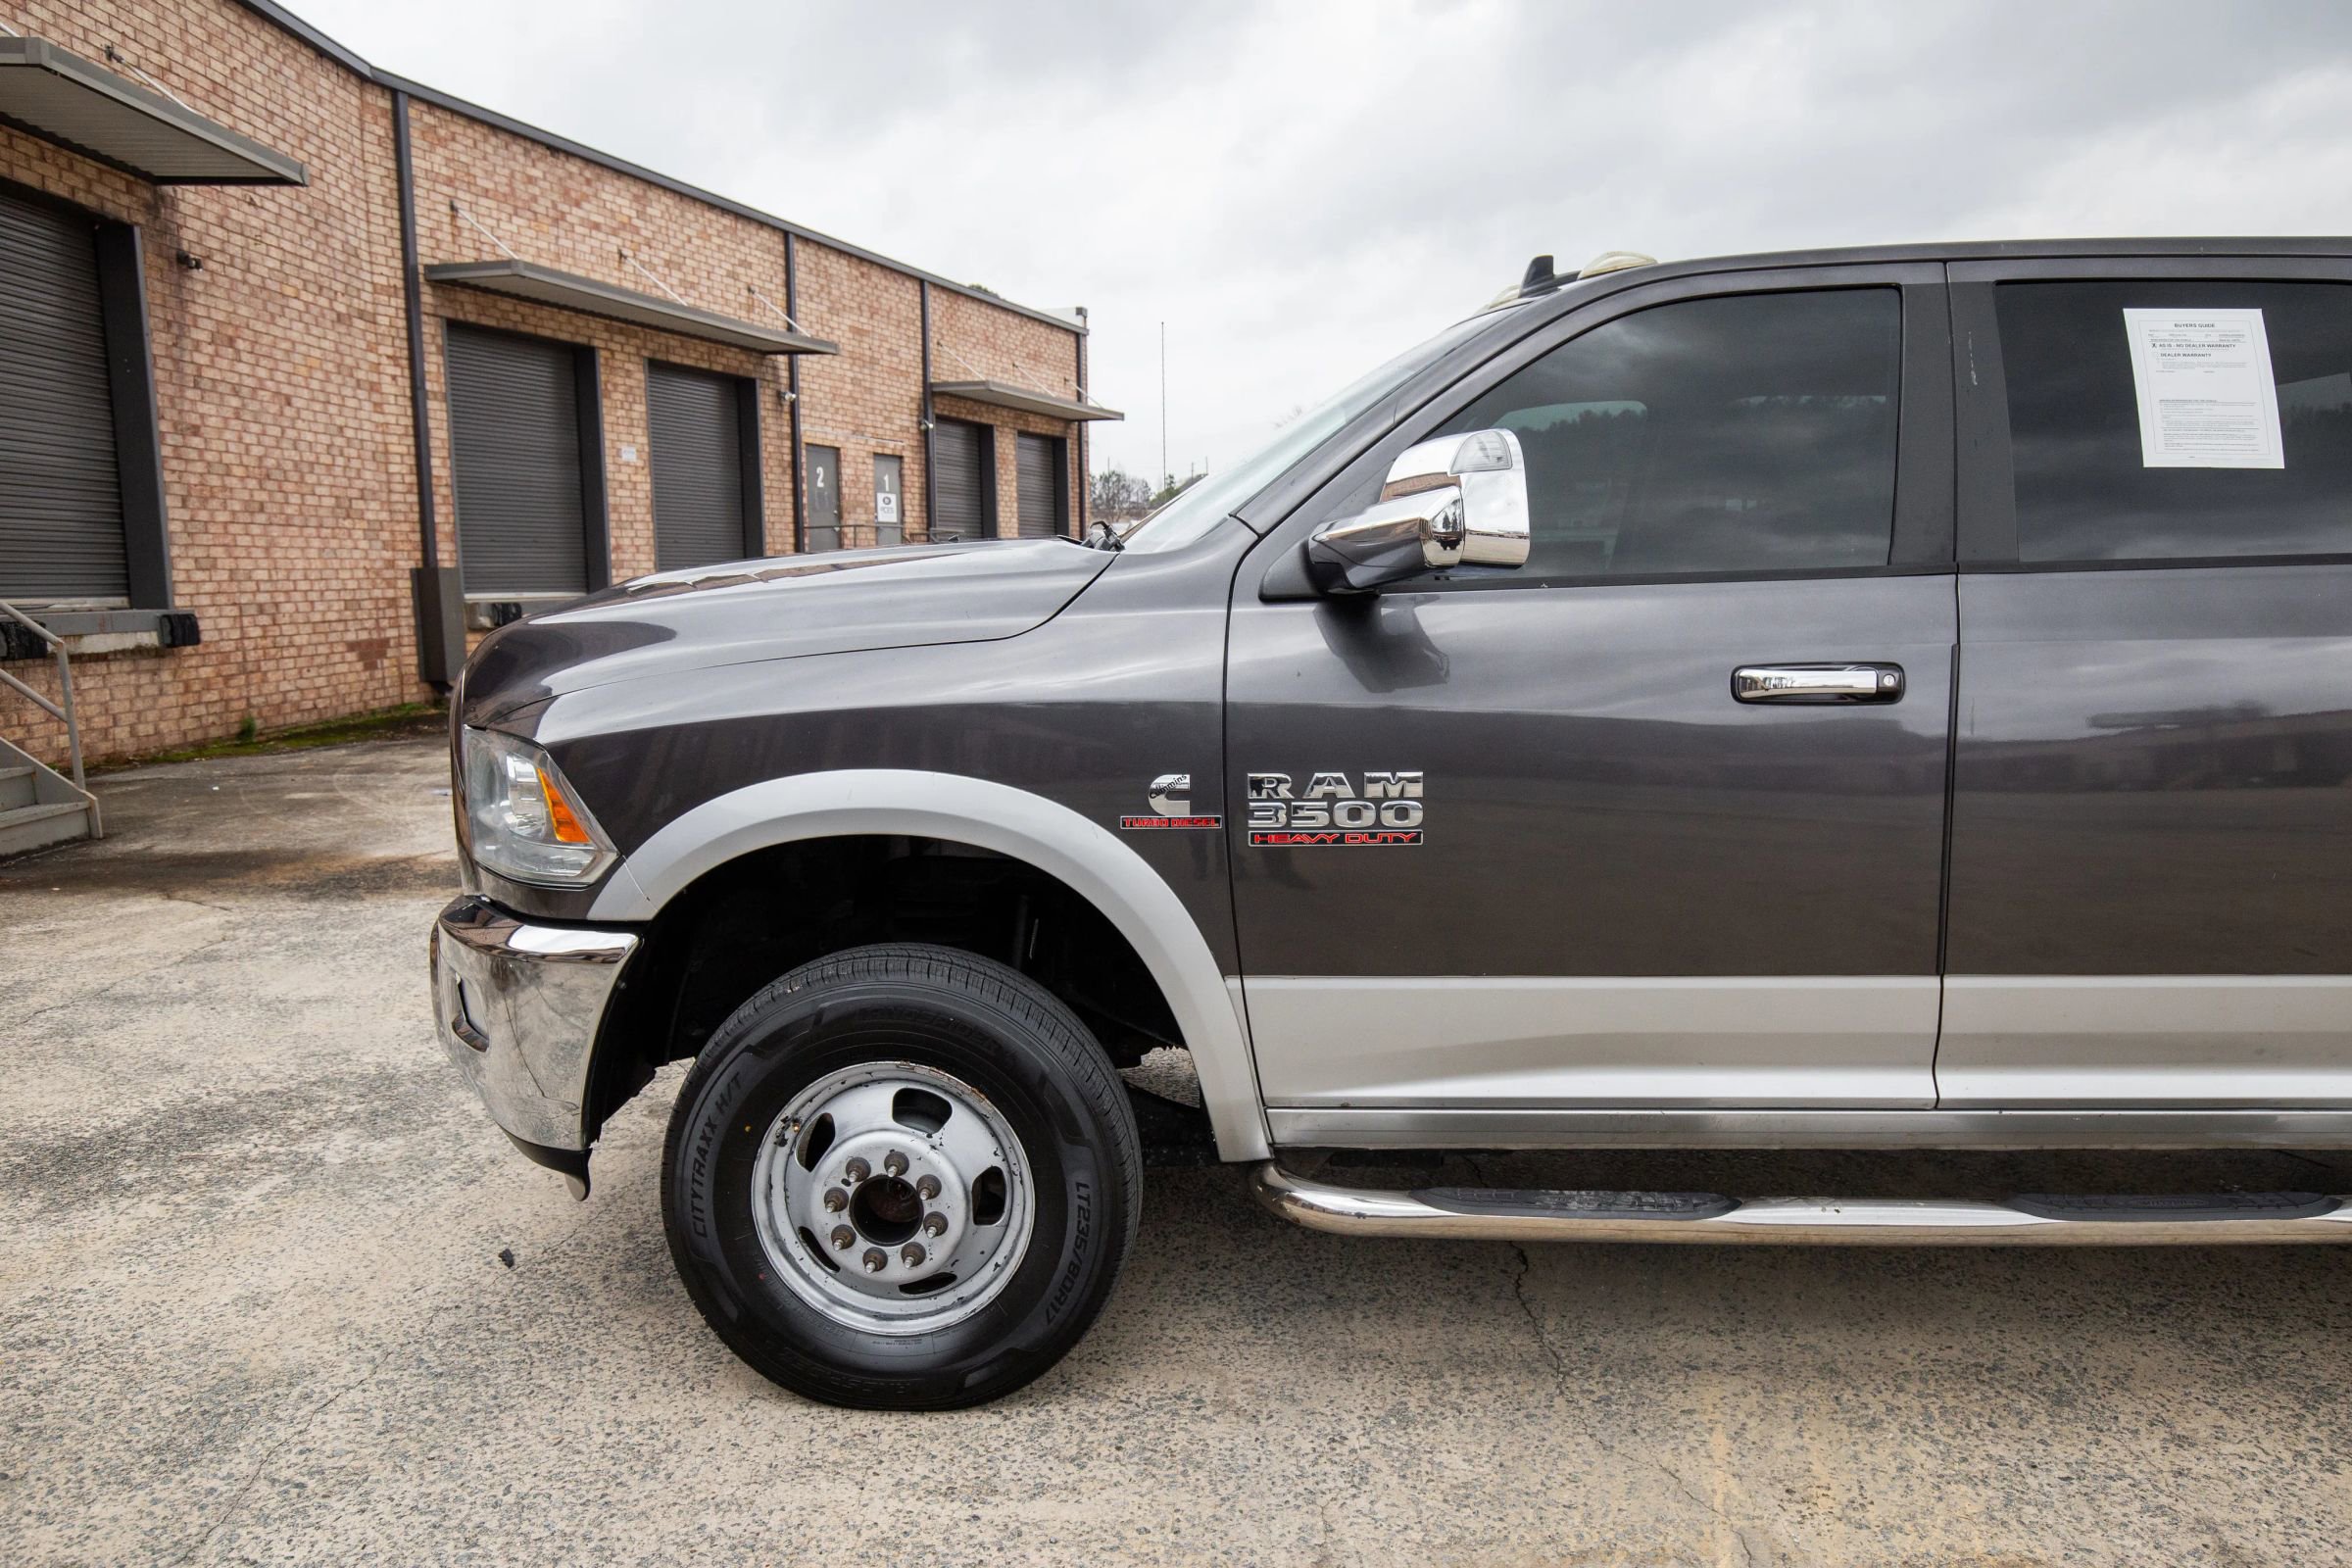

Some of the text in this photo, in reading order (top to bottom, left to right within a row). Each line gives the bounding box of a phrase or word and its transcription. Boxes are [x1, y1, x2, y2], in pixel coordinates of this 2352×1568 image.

[816, 466, 824, 488] 2
[883, 474, 890, 492] 1
[1247, 771, 1424, 800] RAM
[1123, 817, 1220, 828] TURBO DIESEL
[1247, 801, 1424, 828] 3500
[1253, 832, 1418, 844] HEAVY DUTY
[690, 1071, 742, 1239] CITYTRAXX H/T
[1045, 1181, 1092, 1326] LT235/80R17
